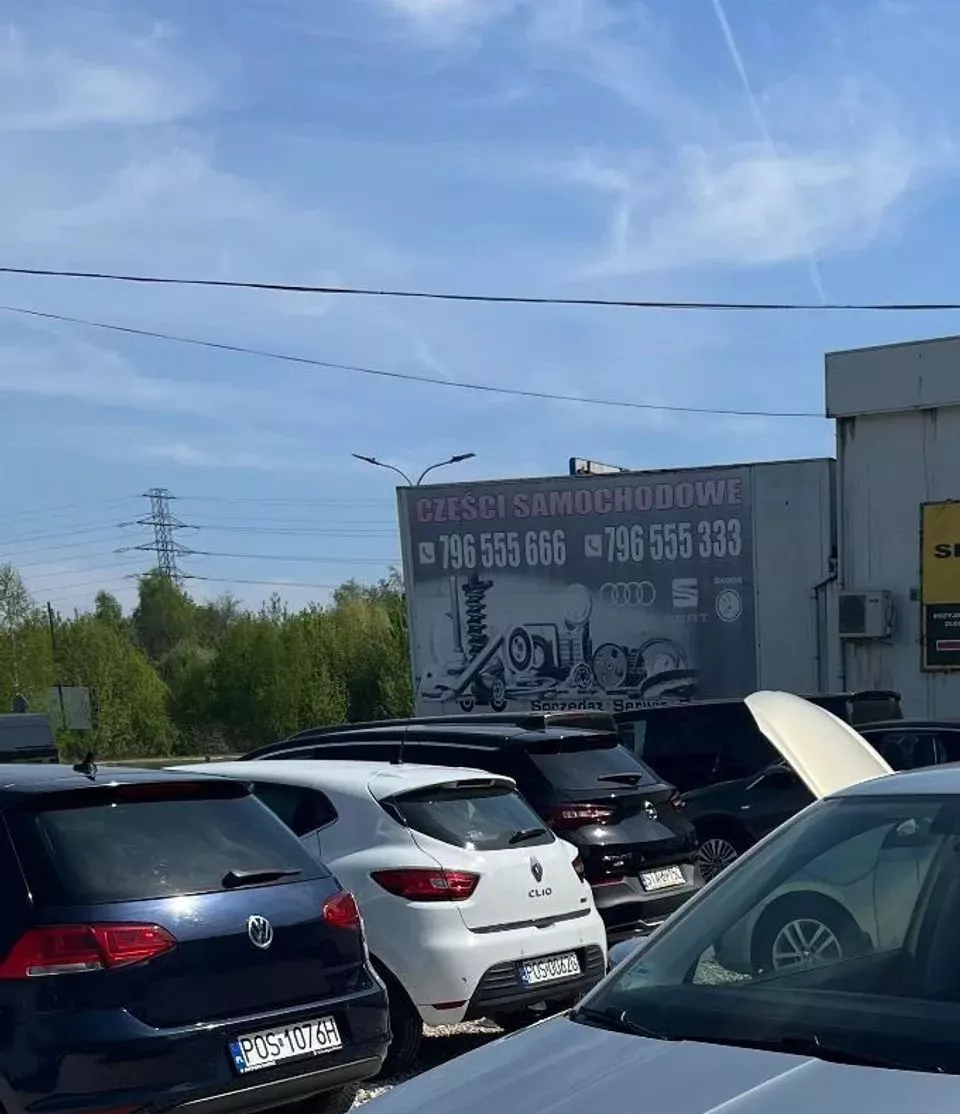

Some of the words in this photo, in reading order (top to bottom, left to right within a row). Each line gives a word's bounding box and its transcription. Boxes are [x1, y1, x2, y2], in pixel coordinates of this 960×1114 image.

[416, 489, 505, 523] CZĘŚCI
[513, 477, 743, 519] SAMOCHODOWE
[439, 533, 475, 570] 796
[481, 531, 521, 568] 555
[525, 529, 567, 567] 666
[604, 525, 641, 563] 796
[649, 521, 693, 562] 555
[697, 518, 742, 558] 333
[528, 887, 552, 898] CLIO
[240, 1032, 281, 1064] POS
[284, 1018, 340, 1053] 1076H
